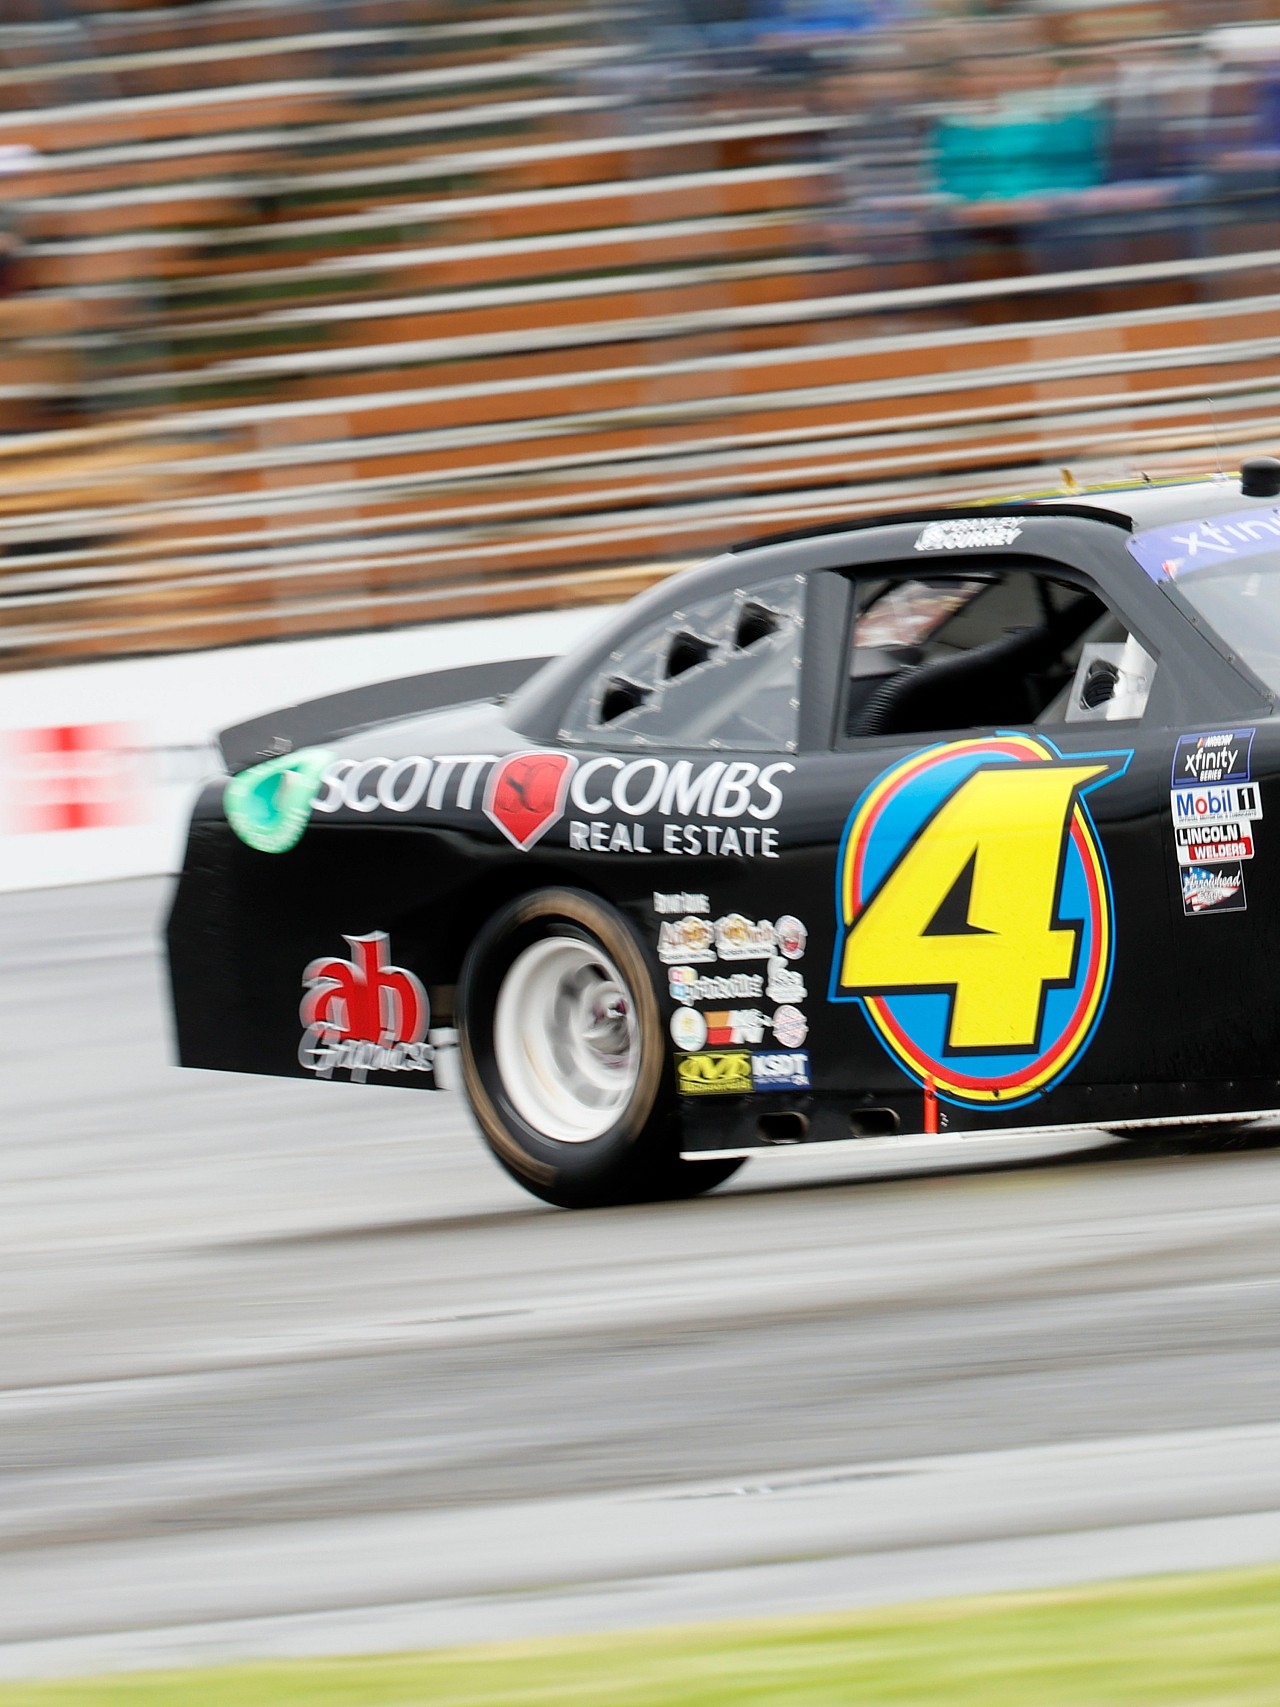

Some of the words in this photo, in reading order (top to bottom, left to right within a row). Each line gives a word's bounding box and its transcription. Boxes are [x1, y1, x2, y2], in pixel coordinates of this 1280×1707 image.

[1204, 734, 1234, 748] NASCAR
[1184, 746, 1238, 777] xfinity
[1200, 768, 1222, 782] SERIES
[310, 755, 502, 813] SCOTT
[570, 756, 796, 820] COMBS
[1176, 789, 1232, 816] Mobil
[569, 820, 652, 853] REAL
[663, 823, 780, 859] ESTATE
[1179, 824, 1238, 846] LINCOLN
[1194, 842, 1246, 859] WELDERS
[841, 765, 1109, 1048] 4
